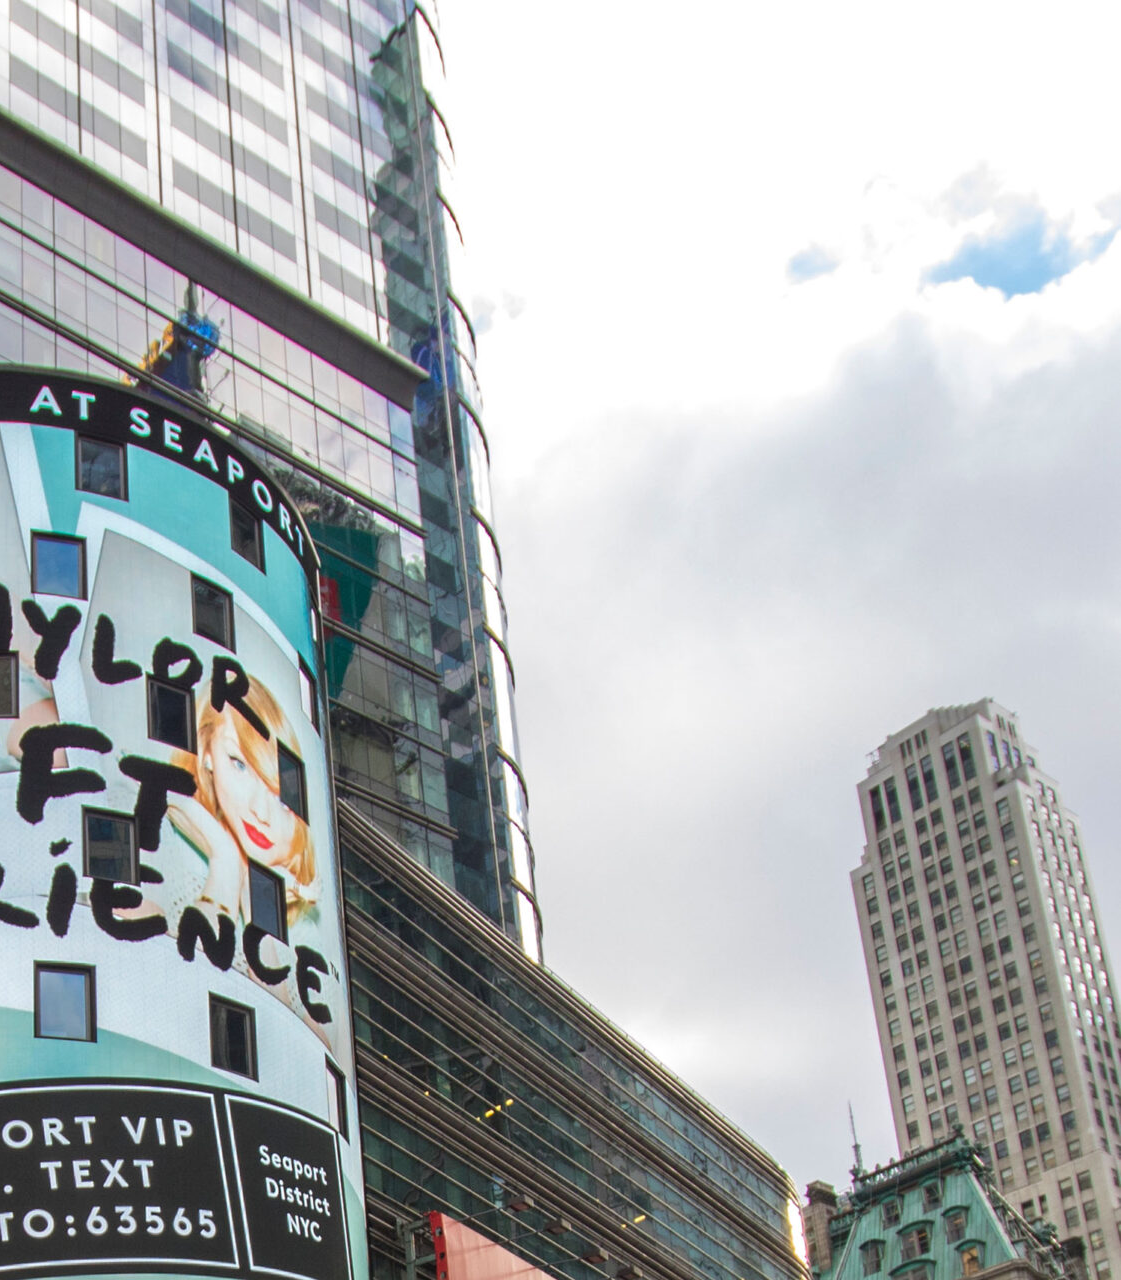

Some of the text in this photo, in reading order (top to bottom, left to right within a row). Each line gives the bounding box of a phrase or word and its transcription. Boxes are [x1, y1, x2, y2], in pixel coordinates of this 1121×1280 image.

[30, 385, 96, 419] AT
[129, 407, 306, 557] SEAPORT
[120, 1118, 195, 1147] VIP
[40, 1159, 156, 1190] TEXT
[258, 1144, 328, 1188] Seaport
[264, 1177, 332, 1218] District
[287, 1215, 323, 1243] NYC
